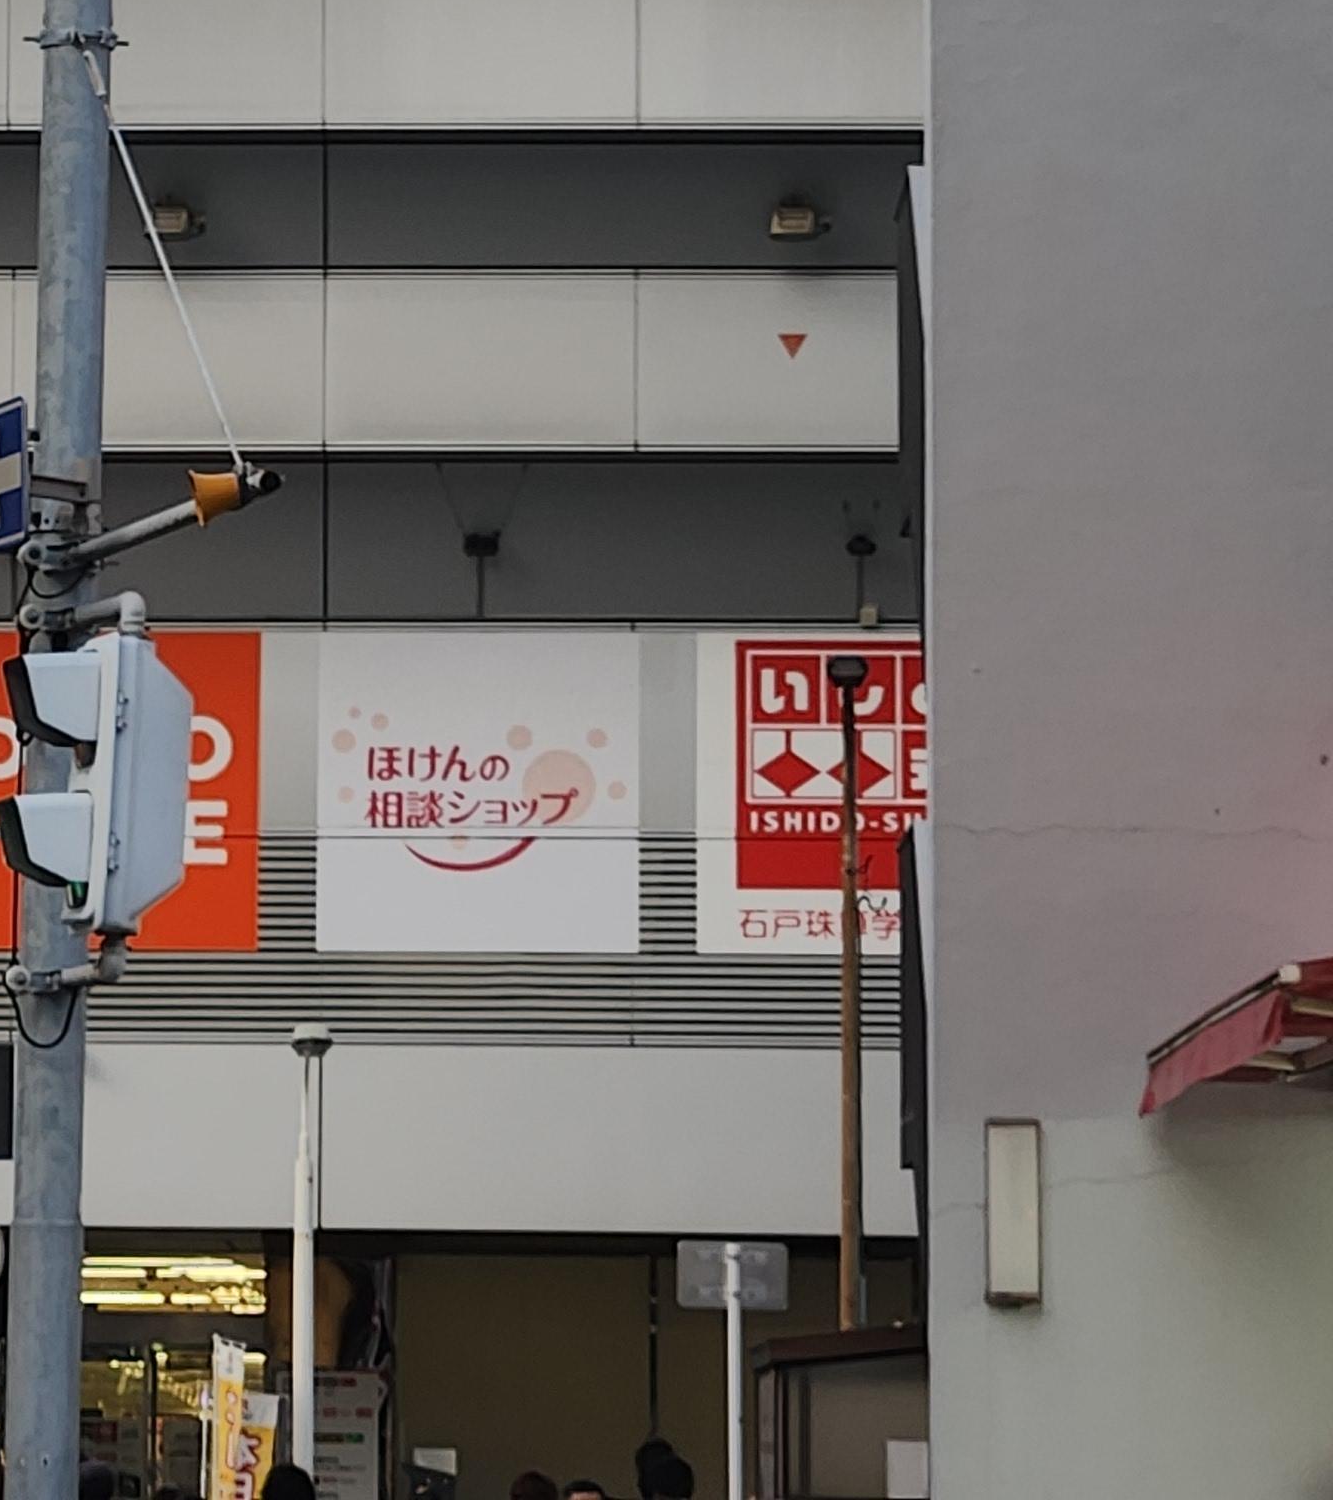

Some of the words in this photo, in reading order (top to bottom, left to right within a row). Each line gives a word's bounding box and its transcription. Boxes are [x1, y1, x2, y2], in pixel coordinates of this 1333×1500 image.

[367, 745, 510, 782] ほけんの
[364, 787, 580, 828] 相談ショップ
[739, 909, 901, 941] 石戸珠学
